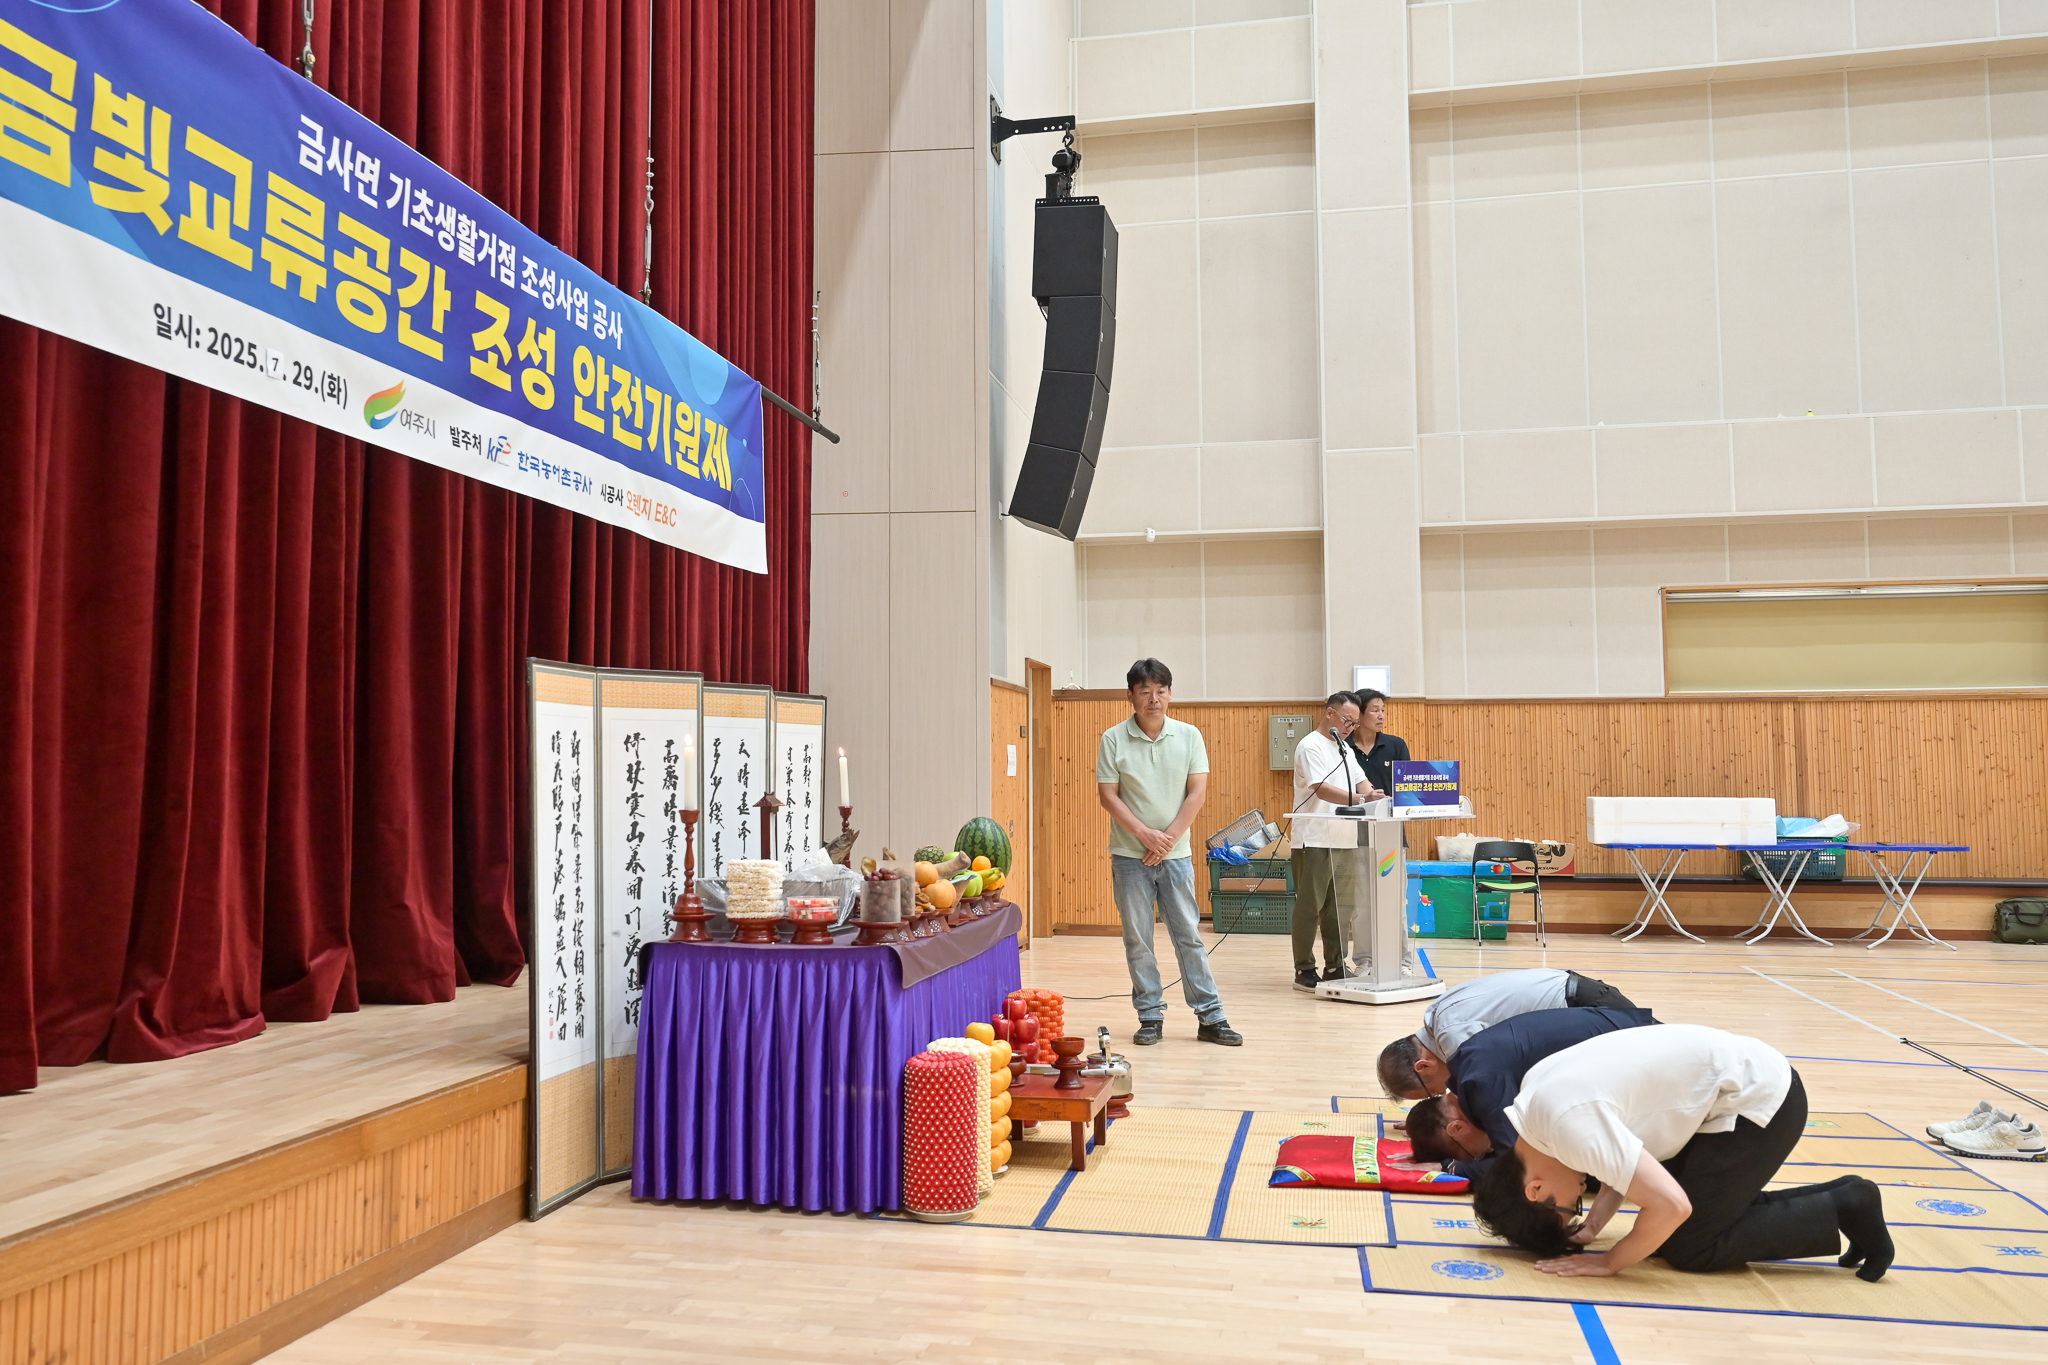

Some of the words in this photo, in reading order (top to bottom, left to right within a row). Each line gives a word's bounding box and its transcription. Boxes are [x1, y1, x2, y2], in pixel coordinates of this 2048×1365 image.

[298, 114, 381, 209] 금사면
[386, 168, 516, 289] 기초생활거점
[520, 255, 589, 330] 조성사업
[592, 299, 624, 350] 공사
[0, 18, 451, 362] 금빛교류공간
[469, 290, 556, 411] 조성
[572, 345, 733, 492] 안전기원제
[153, 303, 201, 349] 일시:
[400, 408, 437, 439] 여주시
[449, 426, 482, 456] 발주처
[517, 451, 593, 495] 한국농어촌공사
[600, 483, 624, 507] 시공사
[626, 490, 653, 521] 오렌지
[654, 502, 678, 528] E&C
